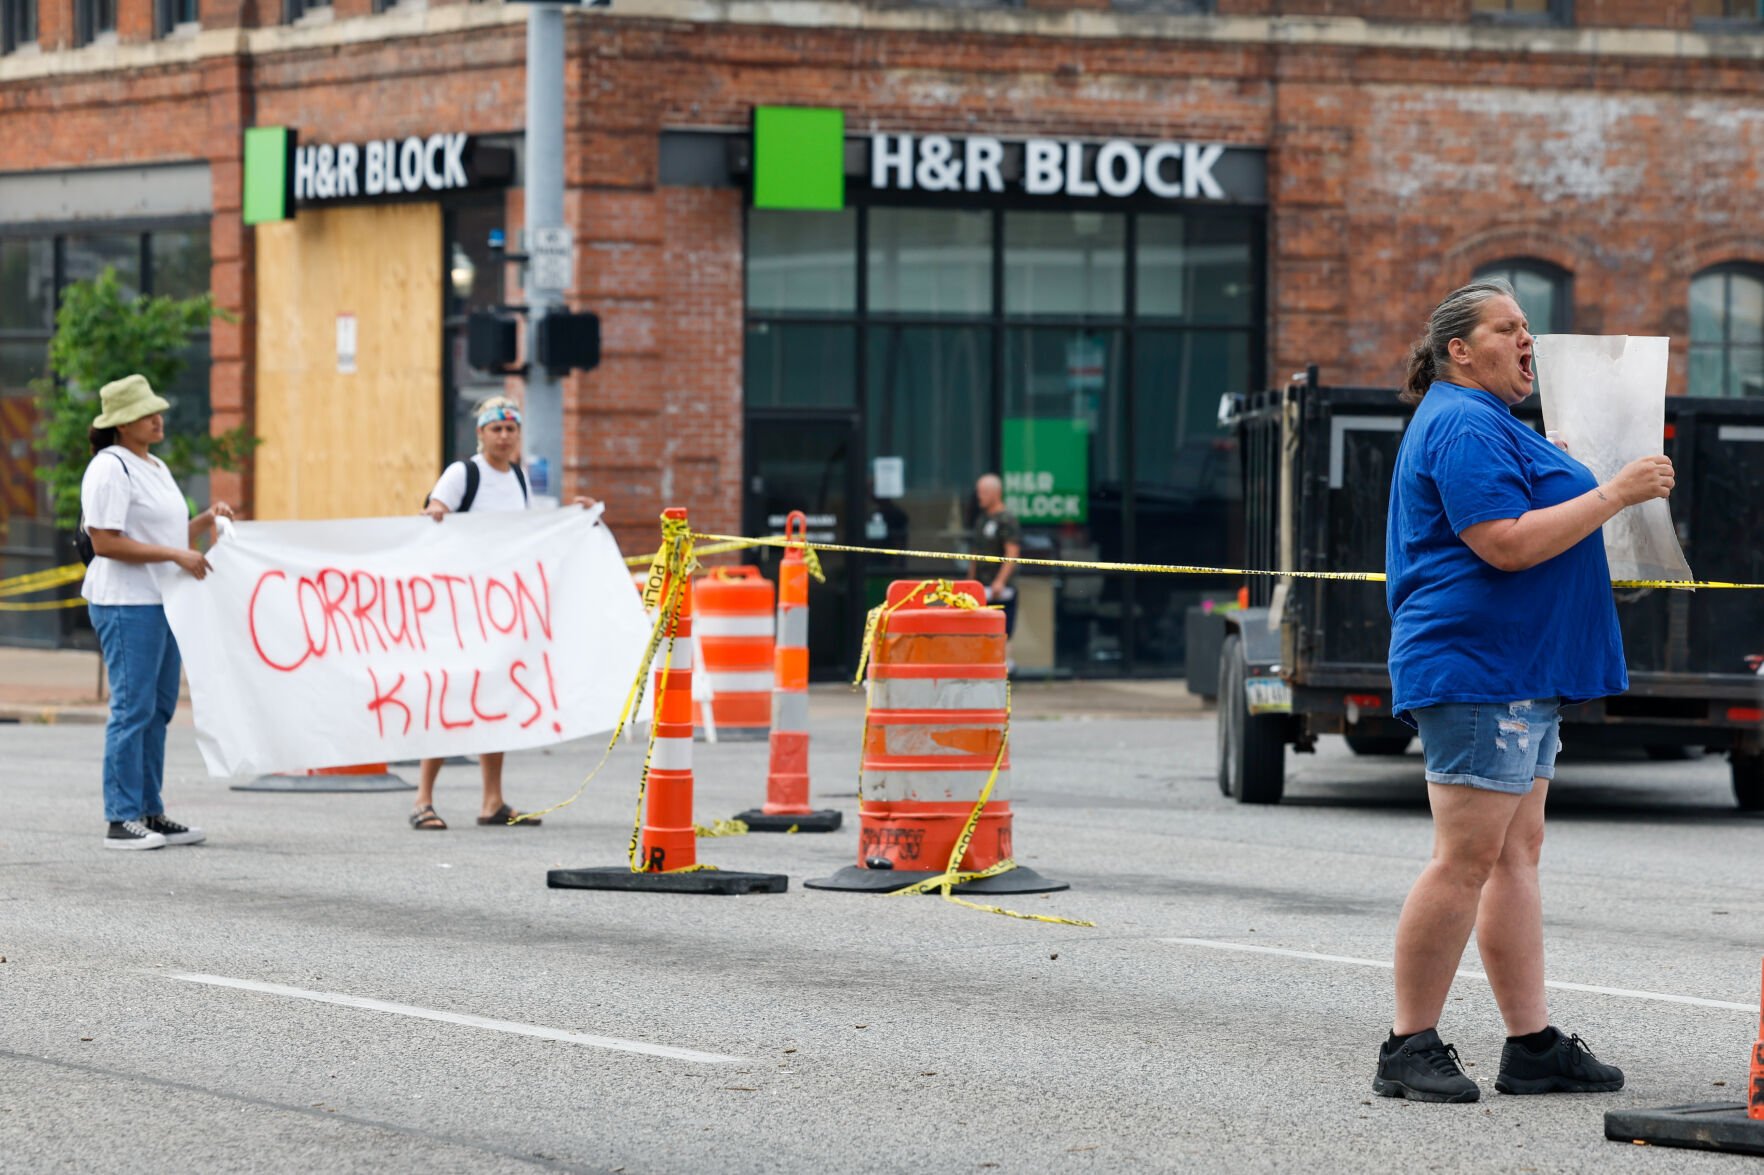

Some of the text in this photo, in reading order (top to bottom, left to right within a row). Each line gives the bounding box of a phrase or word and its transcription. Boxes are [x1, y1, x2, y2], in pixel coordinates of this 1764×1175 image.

[294, 131, 468, 198] H&R BLOCK
[871, 134, 1225, 199] H&R BLOCK
[1004, 471, 1055, 494] H&R
[1005, 494, 1081, 518] BLOCK
[248, 560, 552, 672] CORRUPTION
[367, 651, 563, 738] KILLS!
